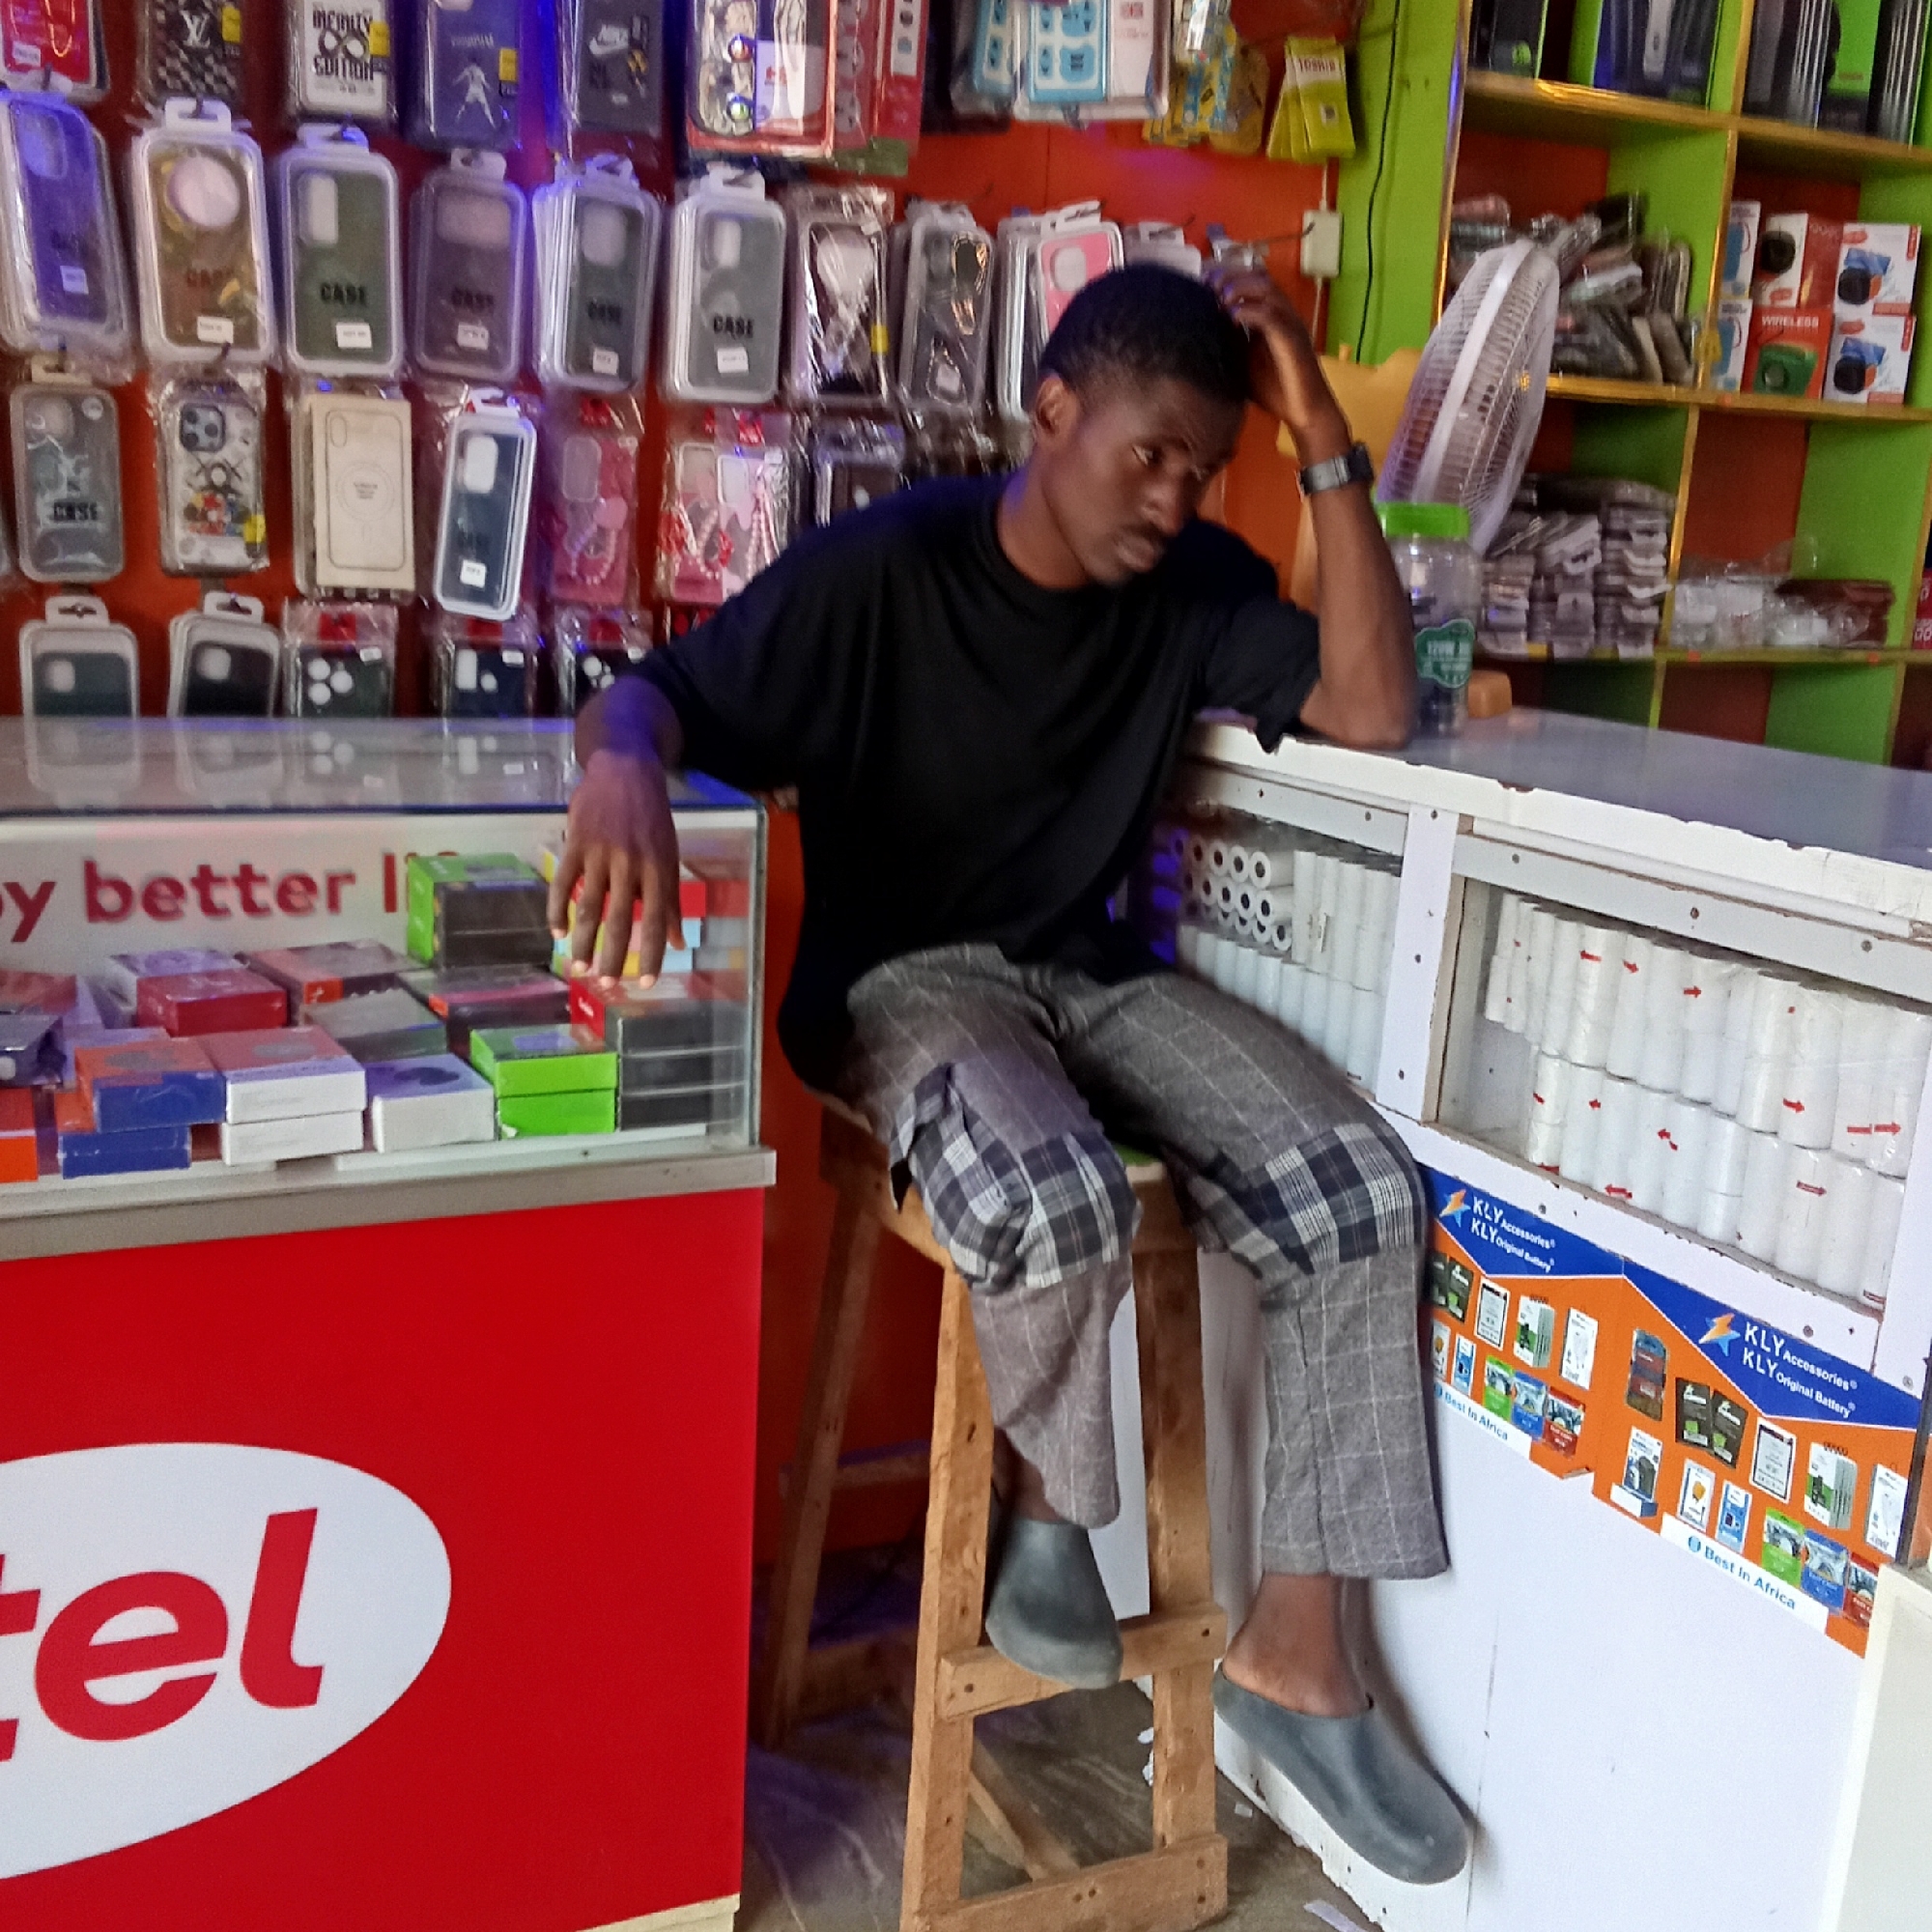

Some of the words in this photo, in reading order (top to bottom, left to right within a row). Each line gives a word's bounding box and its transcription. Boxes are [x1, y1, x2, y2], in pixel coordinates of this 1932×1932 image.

[713, 313, 754, 339] CASE
[83, 859, 356, 924] better
[1472, 1196, 1503, 1223] KLY
[1471, 1217, 1498, 1243] KLY
[1745, 1321, 1785, 1356] KLY
[1743, 1347, 1778, 1378] KLY
[1776, 1372, 1814, 1400] Original
[1704, 1546, 1736, 1574] Best
[1752, 1577, 1796, 1610] Africa
